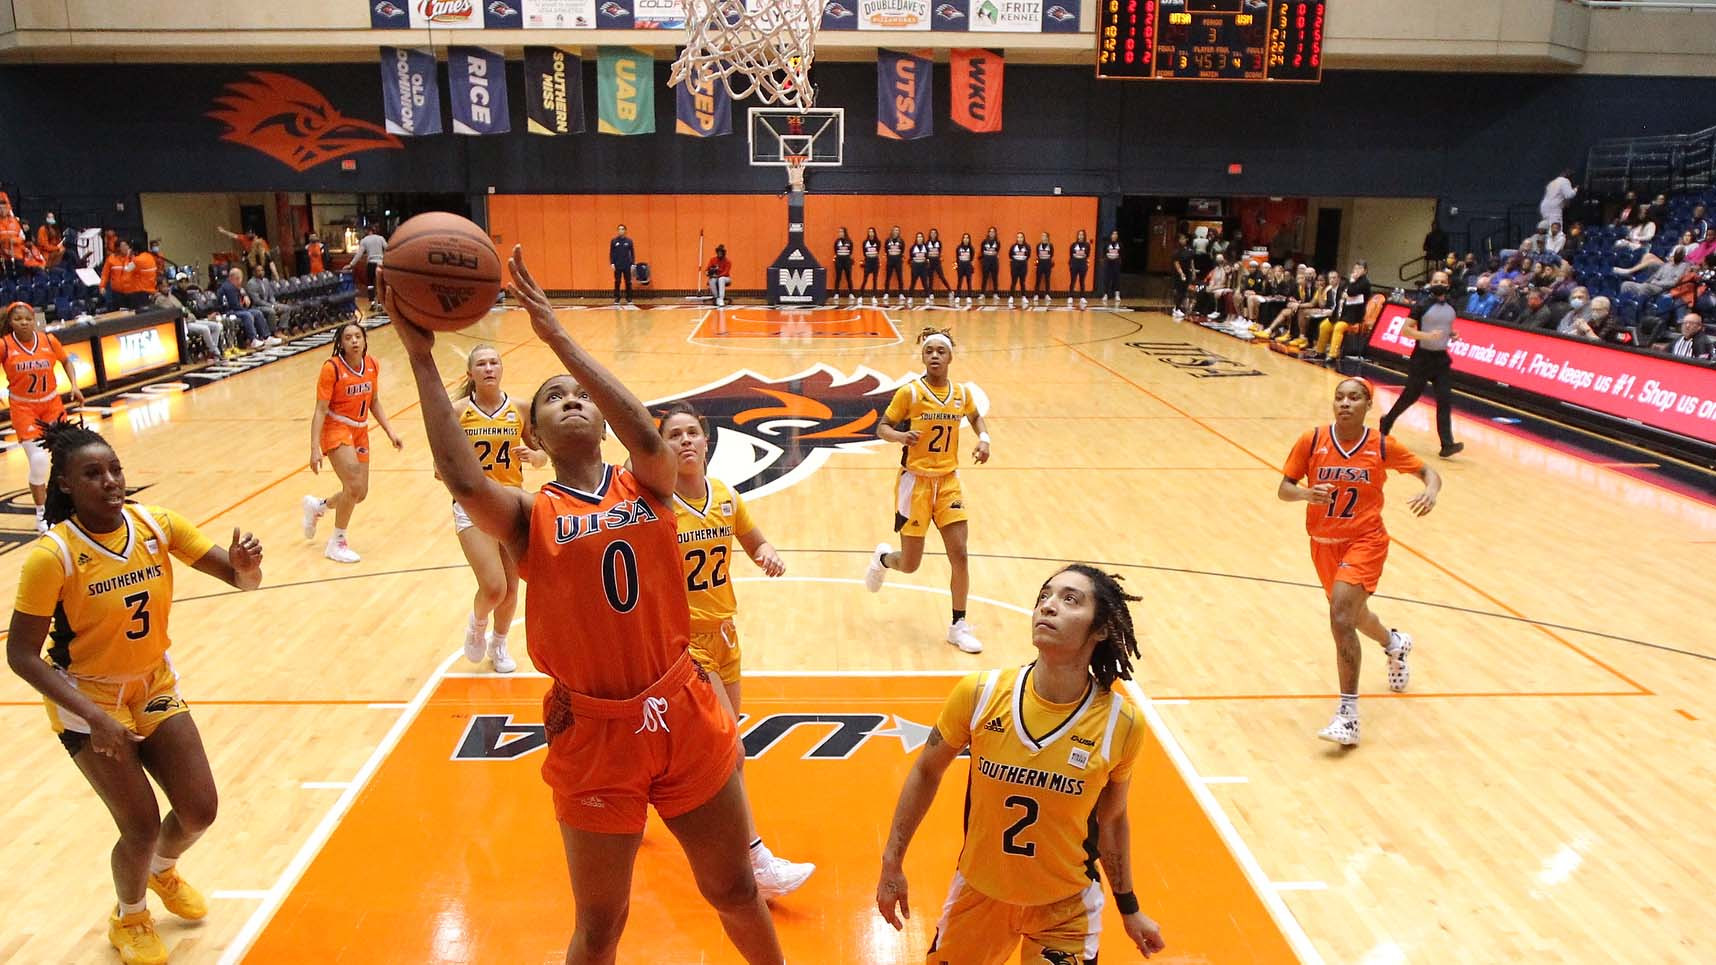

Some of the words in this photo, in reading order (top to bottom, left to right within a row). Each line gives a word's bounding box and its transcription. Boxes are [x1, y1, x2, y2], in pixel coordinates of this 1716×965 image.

[1000, 13, 1040, 21] KENNEL
[1006, 2, 1040, 13] FRITZ
[397, 48, 414, 131] DOMINION
[411, 73, 425, 106] OLD
[467, 55, 491, 125] RICE
[541, 73, 554, 110] MISS
[553, 51, 568, 132] SOUTHERN
[614, 58, 637, 121] UAB
[895, 58, 916, 130] UTSA
[967, 57, 985, 122] WKU
[428, 251, 478, 270] PRO
[27, 373, 49, 395] 21
[1468, 343, 1496, 363] made
[1494, 350, 1510, 367] us
[1529, 353, 1559, 379] Price
[1558, 360, 1595, 389] keeps
[1593, 375, 1614, 393] us
[1638, 379, 1678, 412] Shop
[1676, 394, 1700, 415] us
[358, 399, 367, 418] 1
[464, 427, 502, 437] SOUTHERN
[503, 427, 519, 437] MISS
[928, 424, 952, 453] 21
[473, 440, 511, 471] 24
[1317, 466, 1372, 484] UTSA
[555, 496, 659, 544] UTSA
[1325, 486, 1359, 519] 12
[677, 527, 719, 544] OUTHERN
[88, 568, 146, 597] SOUTHERN
[145, 564, 164, 581] MIS
[601, 539, 640, 614] 0
[685, 545, 728, 592] 22
[123, 590, 150, 641] 3
[978, 755, 1049, 788] SOUTHERN
[1048, 772, 1085, 796] MISS
[1002, 794, 1040, 858] 2
